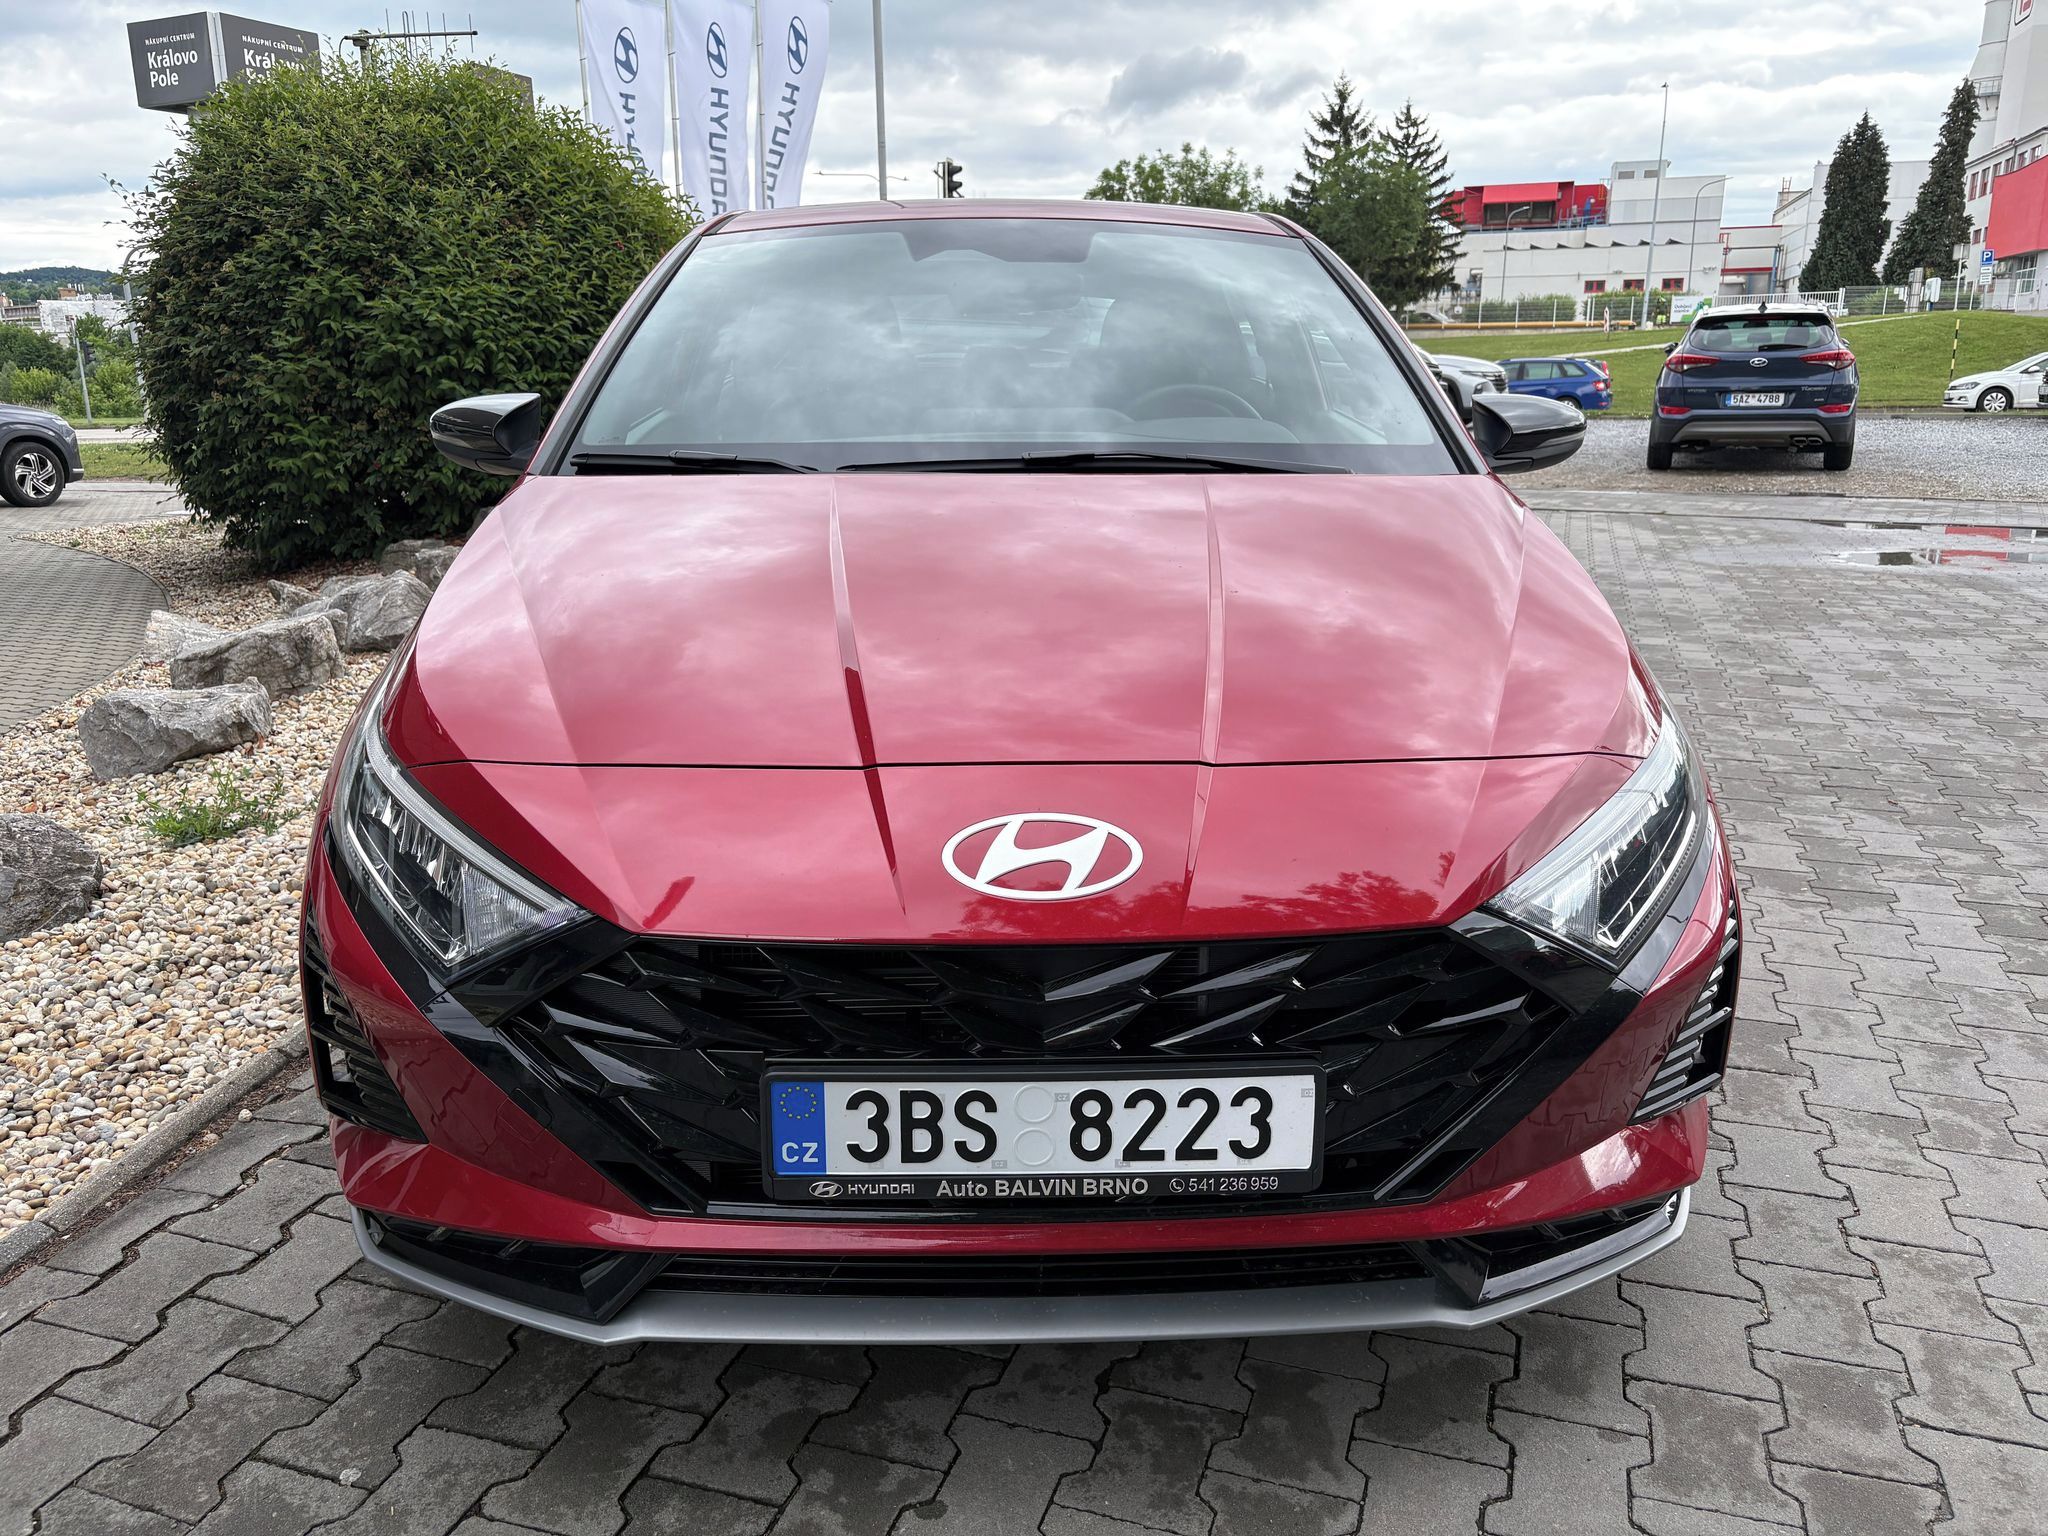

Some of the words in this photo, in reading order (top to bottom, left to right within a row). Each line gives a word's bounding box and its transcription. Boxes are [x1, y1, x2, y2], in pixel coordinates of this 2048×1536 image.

[170, 32, 196, 43] CENTRUM
[272, 41, 303, 54] CENTRUM
[147, 48, 198, 69] Královo
[150, 68, 179, 88] Pole
[1732, 394, 1750, 404] 5AZ
[1757, 394, 1780, 404] 4788
[846, 1089, 998, 1164] 3BS
[1069, 1086, 1273, 1162] 8223
[781, 1142, 819, 1163] CZ
[847, 1183, 915, 1195] HYUNDAI
[936, 1180, 988, 1197] Auto
[995, 1179, 1076, 1197] BALVIN
[1083, 1177, 1149, 1196] BRNO
[1188, 1178, 1215, 1192] 541
[1219, 1177, 1248, 1191] 236
[1250, 1176, 1279, 1191] 959
